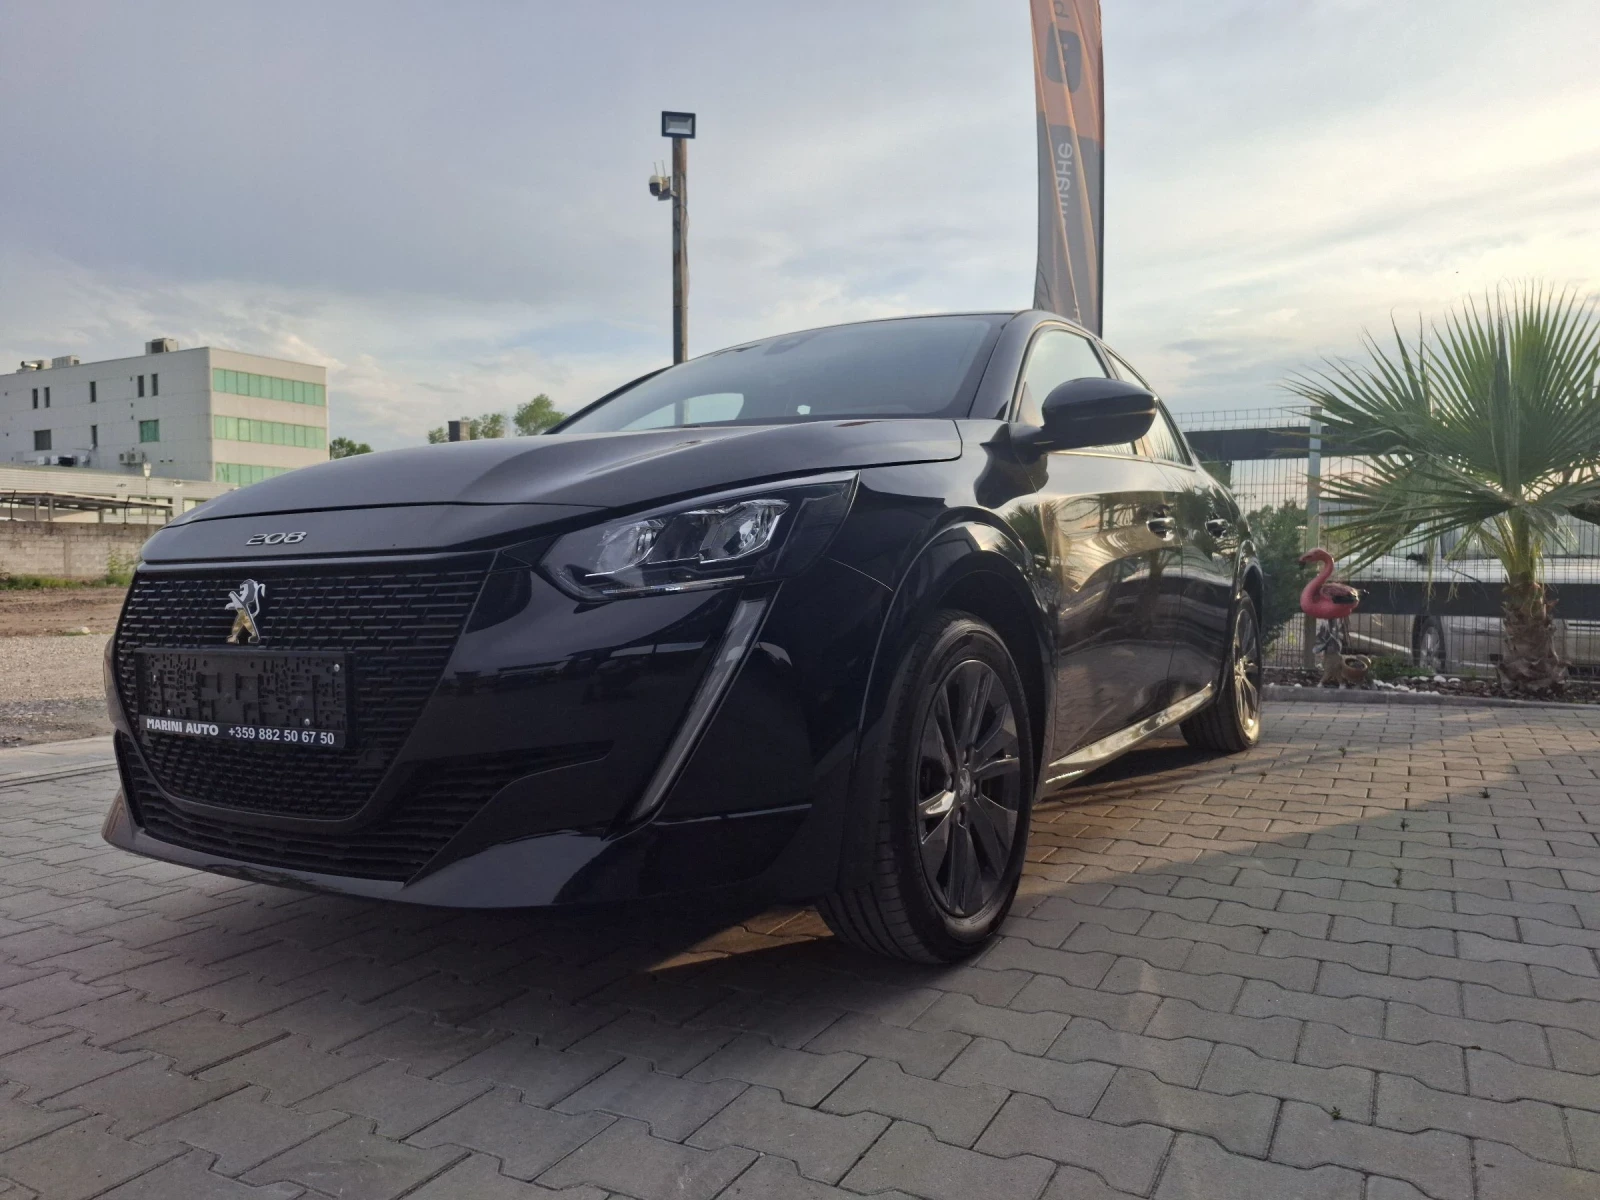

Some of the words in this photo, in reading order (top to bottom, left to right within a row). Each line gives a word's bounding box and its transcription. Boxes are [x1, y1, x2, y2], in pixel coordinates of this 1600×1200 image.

[245, 531, 308, 546] 208
[146, 718, 183, 733] MARINI
[185, 722, 219, 736] AUTO
[228, 727, 256, 739] +359
[258, 728, 280, 741] 882
[283, 729, 298, 742] 50
[301, 730, 316, 743] 67
[320, 732, 335, 745] 50
